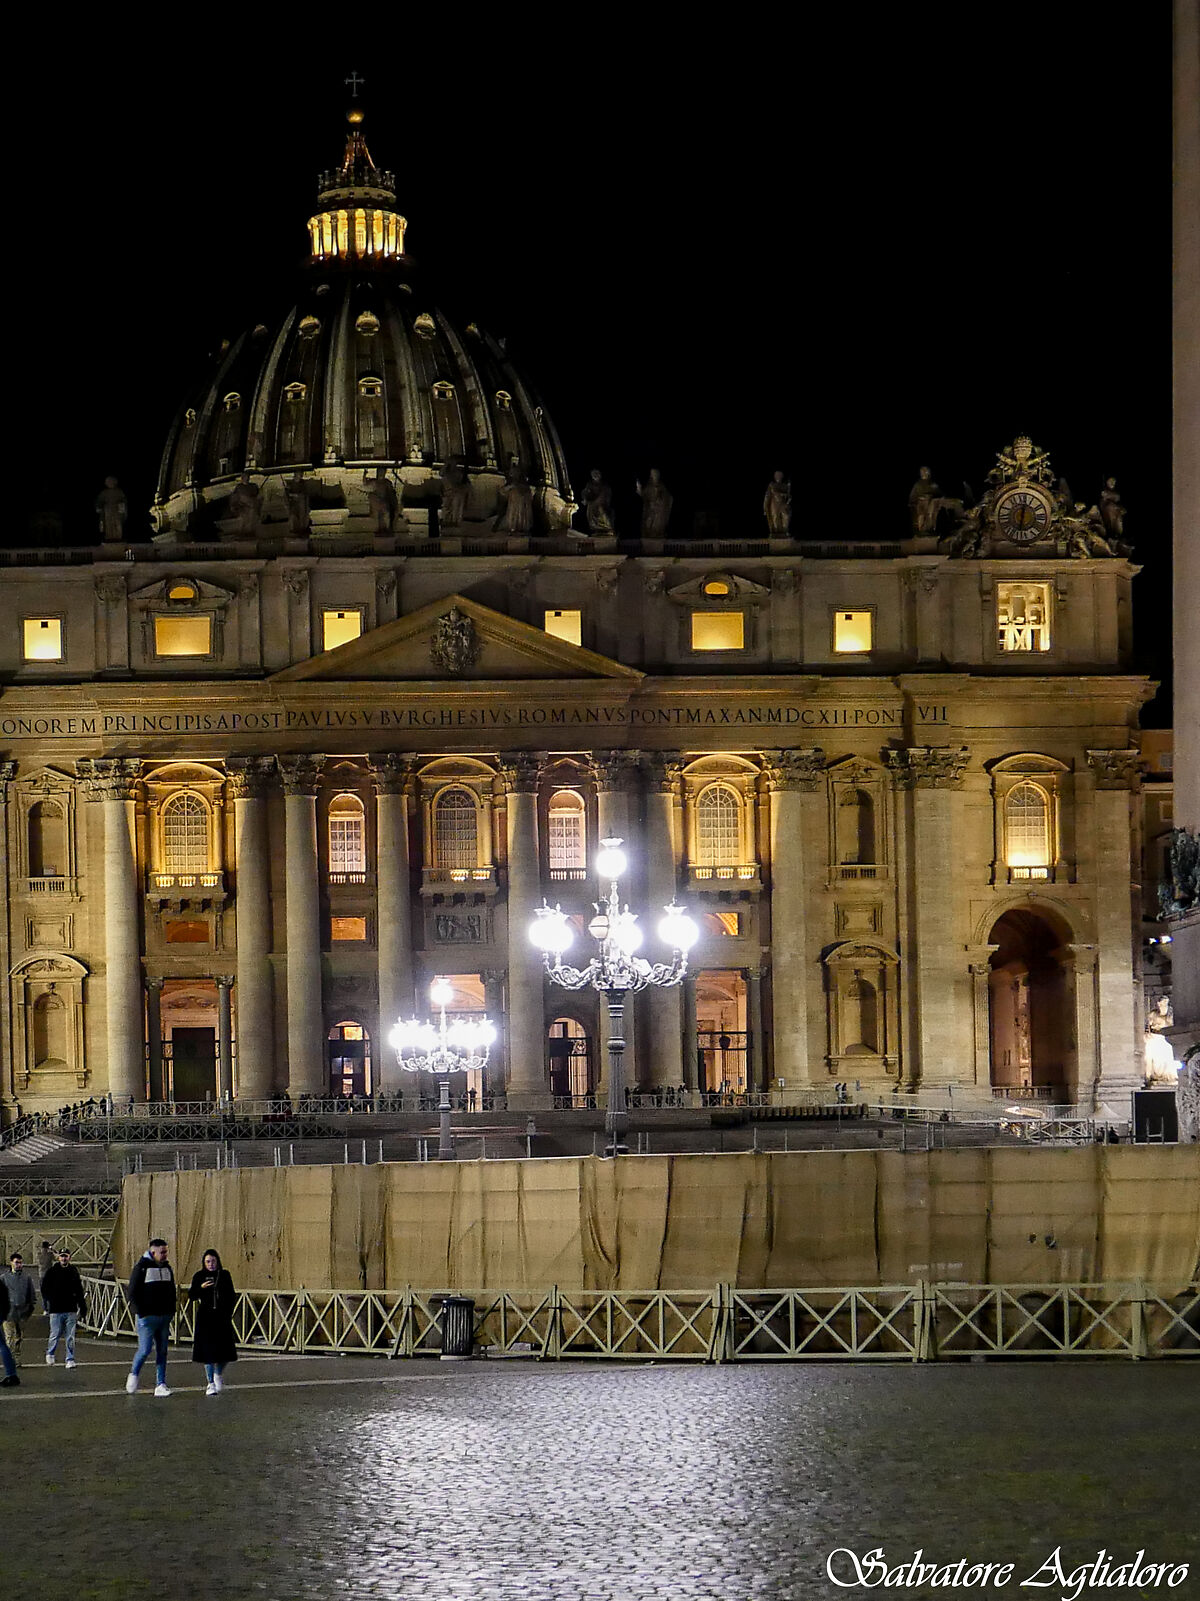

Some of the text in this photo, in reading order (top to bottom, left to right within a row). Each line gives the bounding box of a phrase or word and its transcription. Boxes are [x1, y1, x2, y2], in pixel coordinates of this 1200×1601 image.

[104, 714, 212, 731] PRINCIPIS
[287, 711, 357, 726] PAVLVS
[381, 710, 511, 725] BVRGHESIVS
[519, 708, 625, 725] ROMANVS
